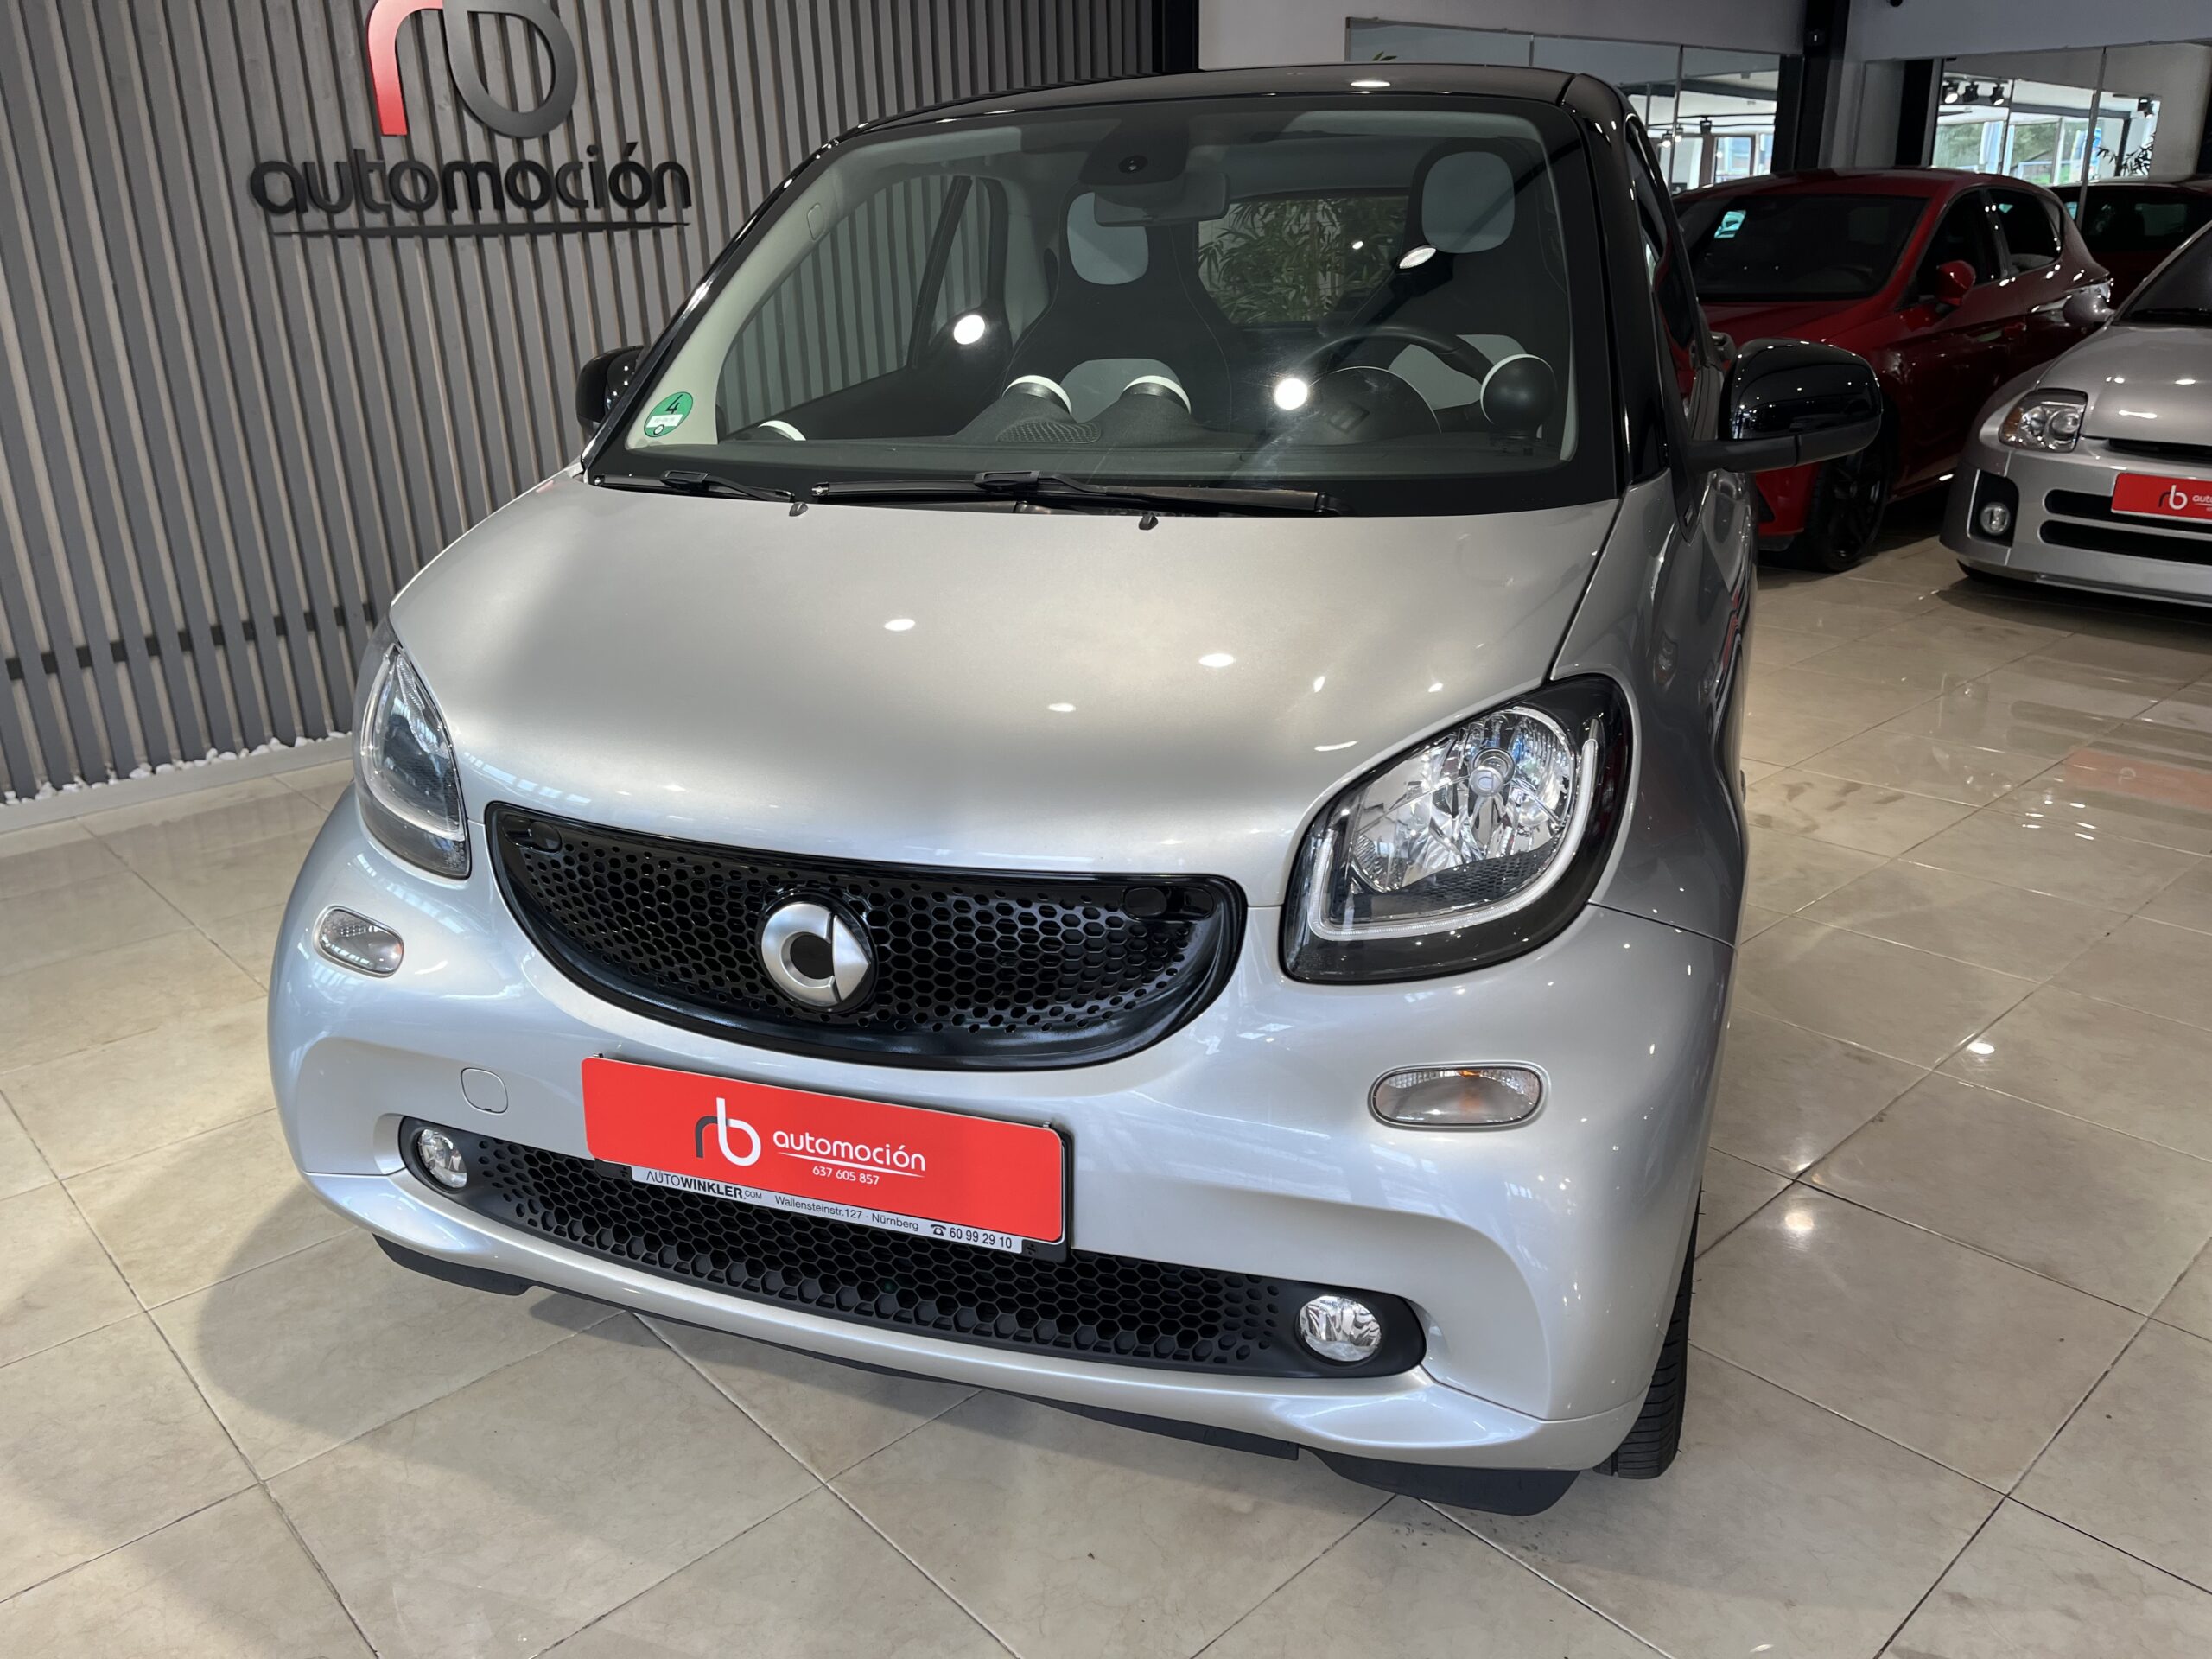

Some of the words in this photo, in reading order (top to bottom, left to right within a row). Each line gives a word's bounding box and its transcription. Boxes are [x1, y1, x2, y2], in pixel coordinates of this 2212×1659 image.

[250, 142, 690, 214] automoción
[665, 394, 683, 414] 4
[2158, 485, 2188, 510] rb
[695, 1097, 761, 1166] rb
[772, 1130, 925, 1171] automoción
[812, 1165, 833, 1178] 637
[836, 1169, 856, 1182] 605
[859, 1172, 880, 1185] 857
[775, 1195, 862, 1219] Wallensteinstr.127
[872, 1213, 919, 1232] Nürnberg
[950, 1227, 963, 1239] 60
[966, 1230, 979, 1243] 99
[982, 1233, 995, 1245] 29
[1000, 1236, 1013, 1249] 10
